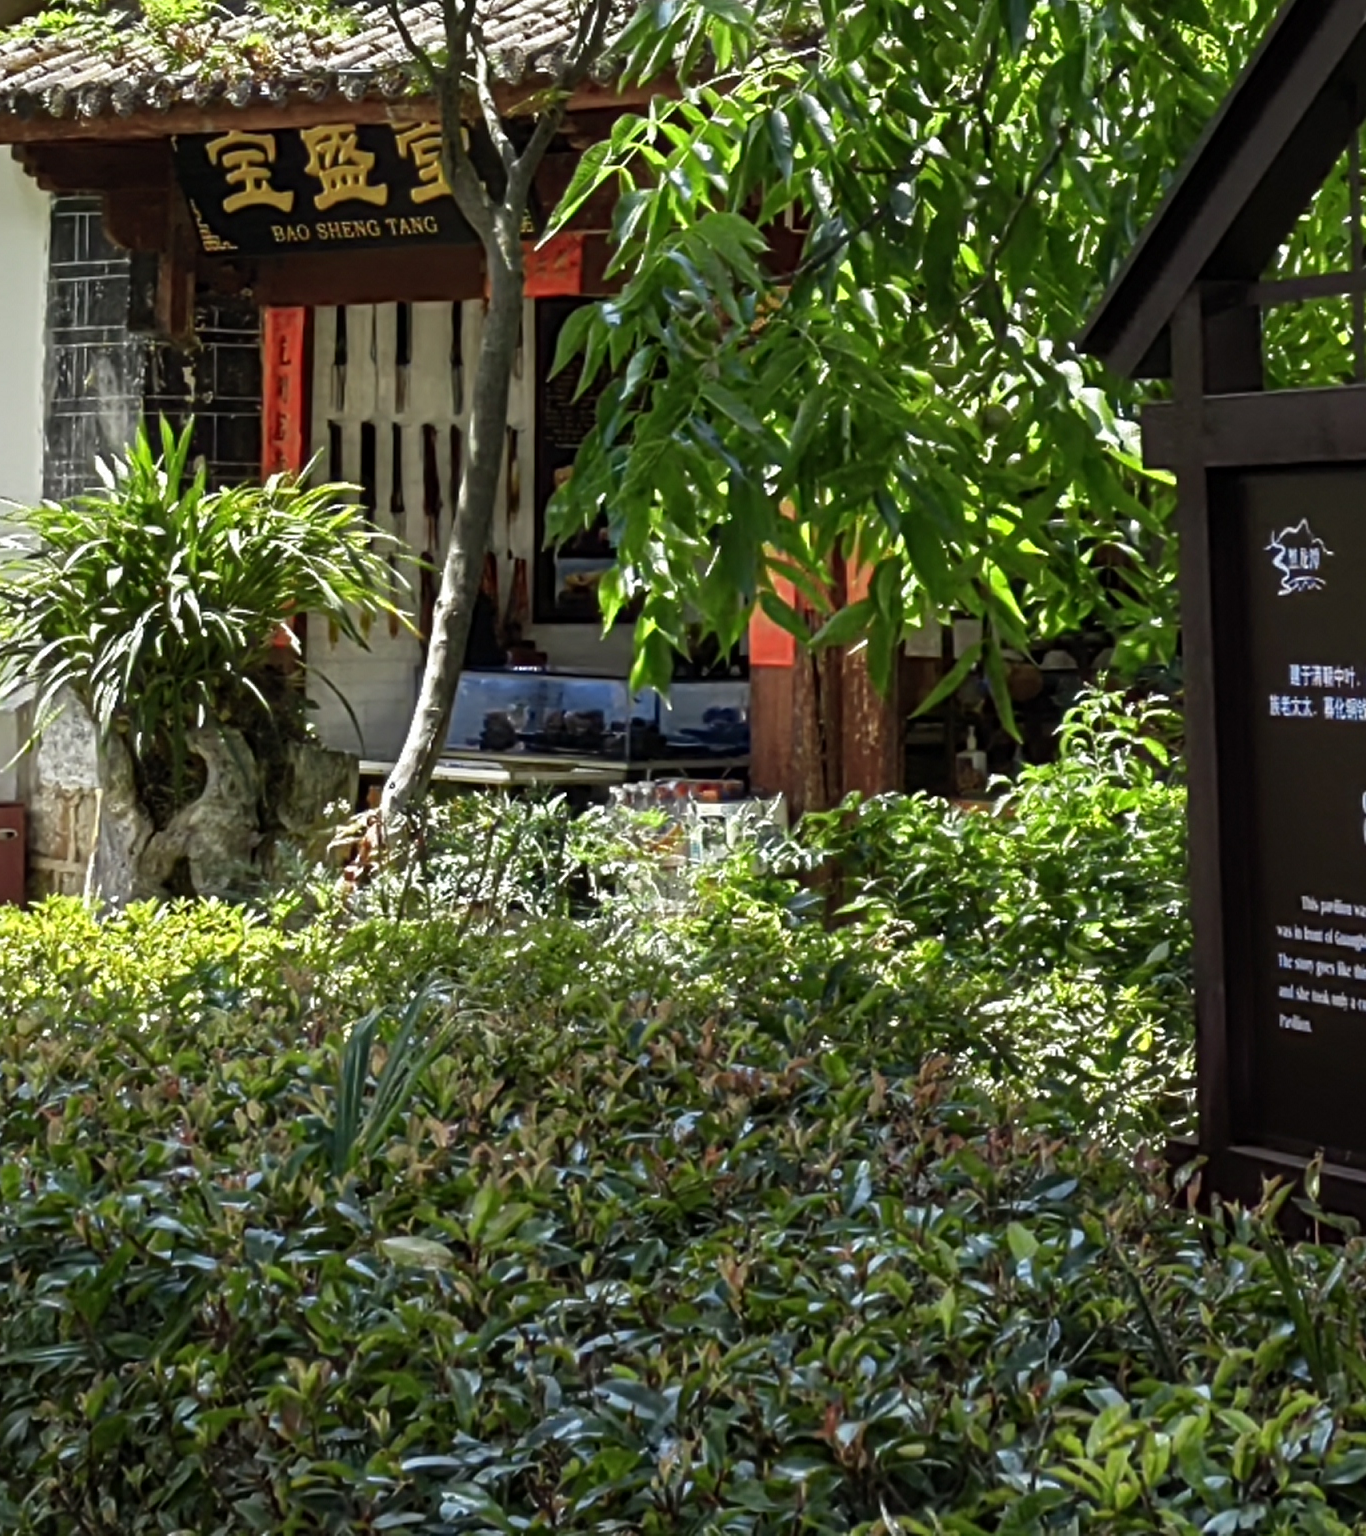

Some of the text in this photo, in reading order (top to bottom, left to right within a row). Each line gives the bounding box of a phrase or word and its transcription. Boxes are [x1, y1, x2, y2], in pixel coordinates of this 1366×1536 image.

[271, 216, 438, 242] BAO SHENG TANG
